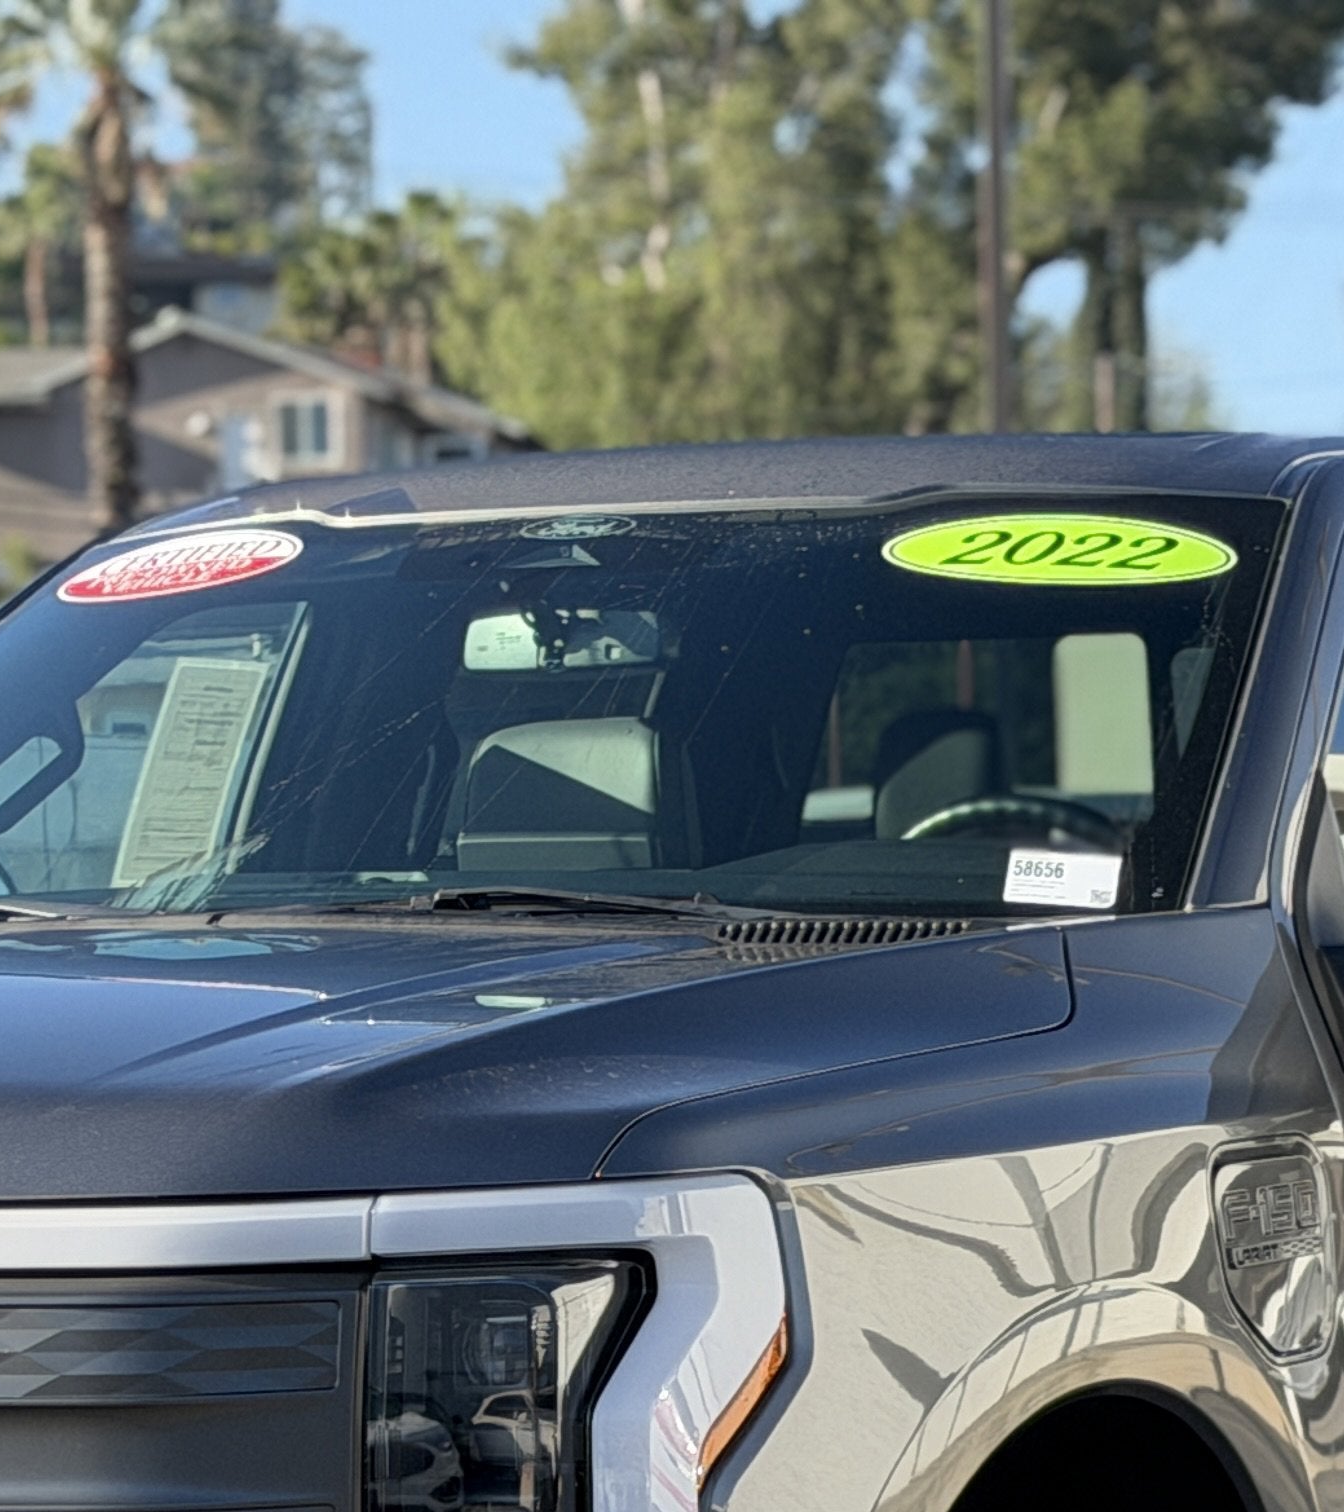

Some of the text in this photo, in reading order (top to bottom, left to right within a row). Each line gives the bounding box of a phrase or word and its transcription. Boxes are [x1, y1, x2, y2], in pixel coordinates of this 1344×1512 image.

[99, 539, 283, 577] CERTIFIED
[938, 530, 1180, 570] 2022
[1013, 860, 1065, 878] 58656
